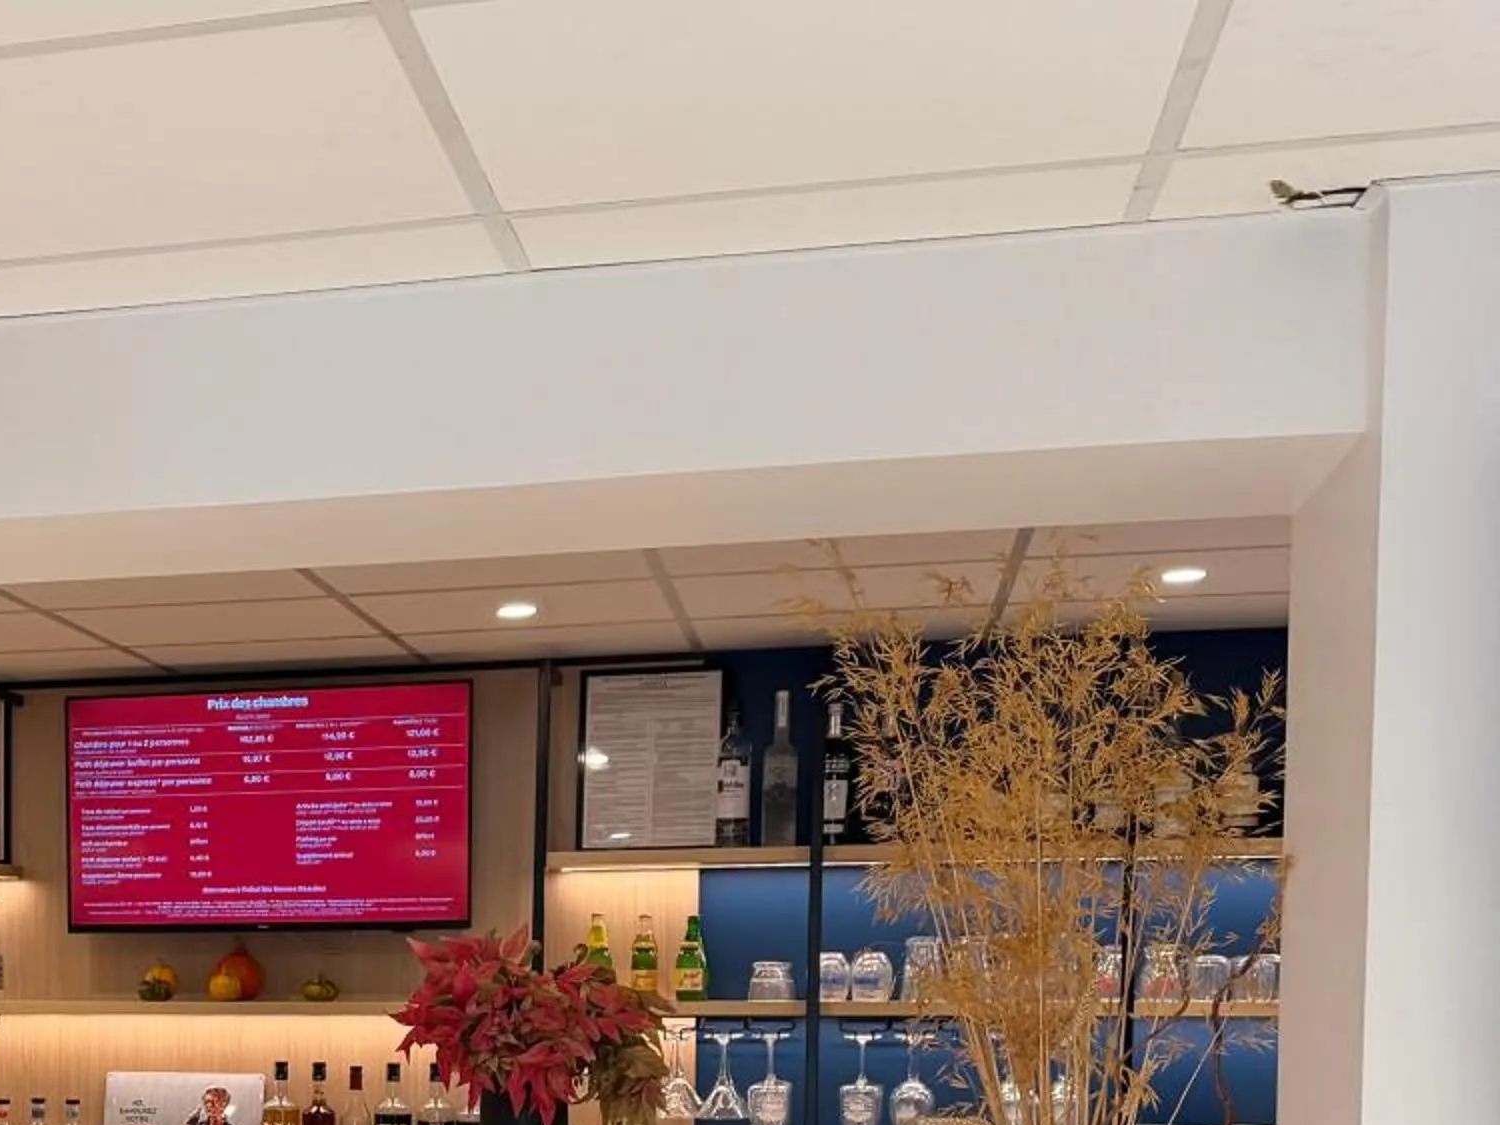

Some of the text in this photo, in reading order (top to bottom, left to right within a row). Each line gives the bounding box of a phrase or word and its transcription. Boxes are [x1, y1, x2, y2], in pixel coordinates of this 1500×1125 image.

[207, 695, 309, 710] Prix des chambres
